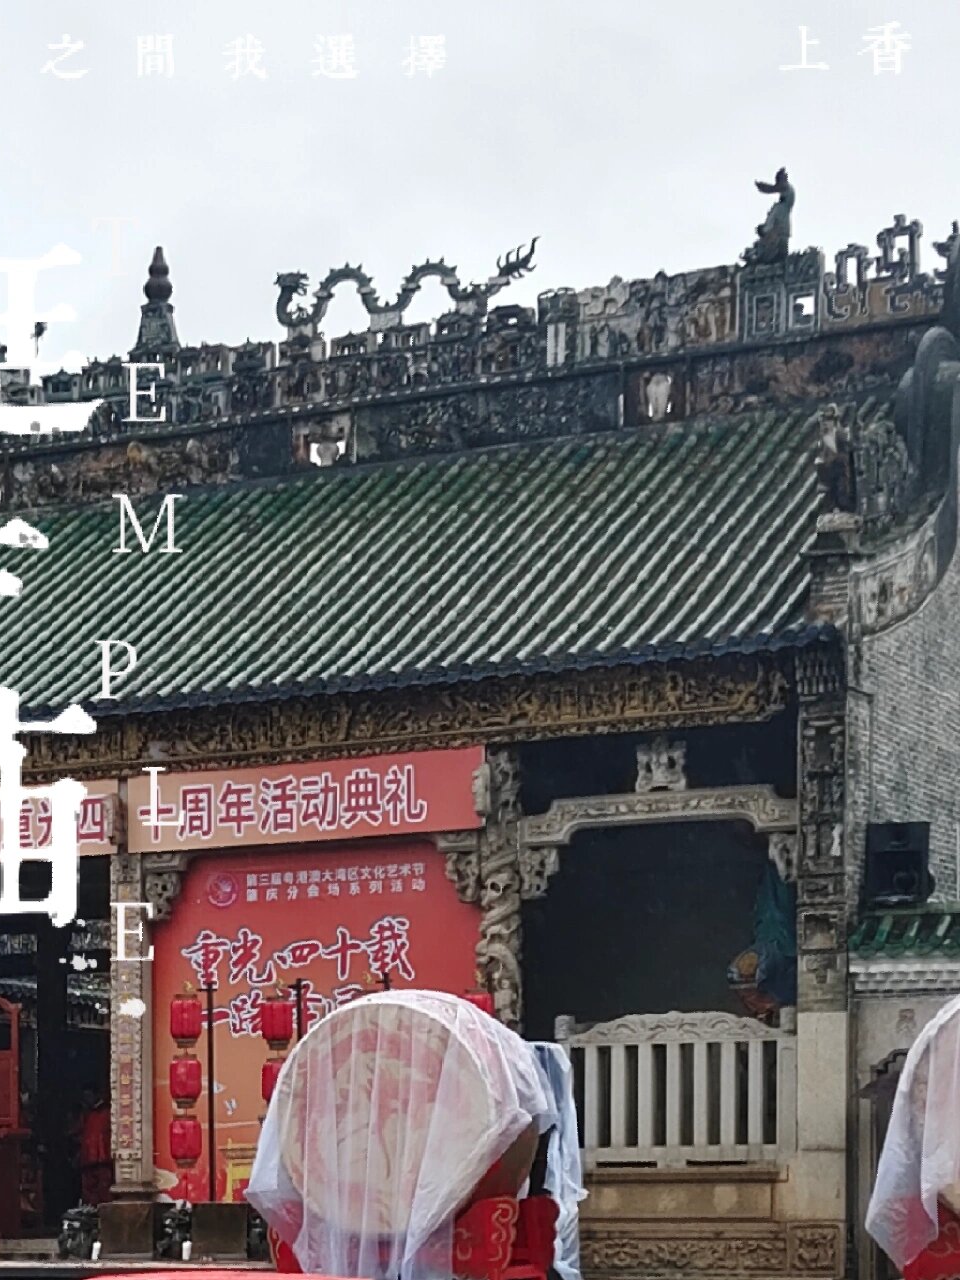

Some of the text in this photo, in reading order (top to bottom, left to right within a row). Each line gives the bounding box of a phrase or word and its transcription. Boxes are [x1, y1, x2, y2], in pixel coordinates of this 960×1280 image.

[138, 764, 427, 842] 十周年活动典礼
